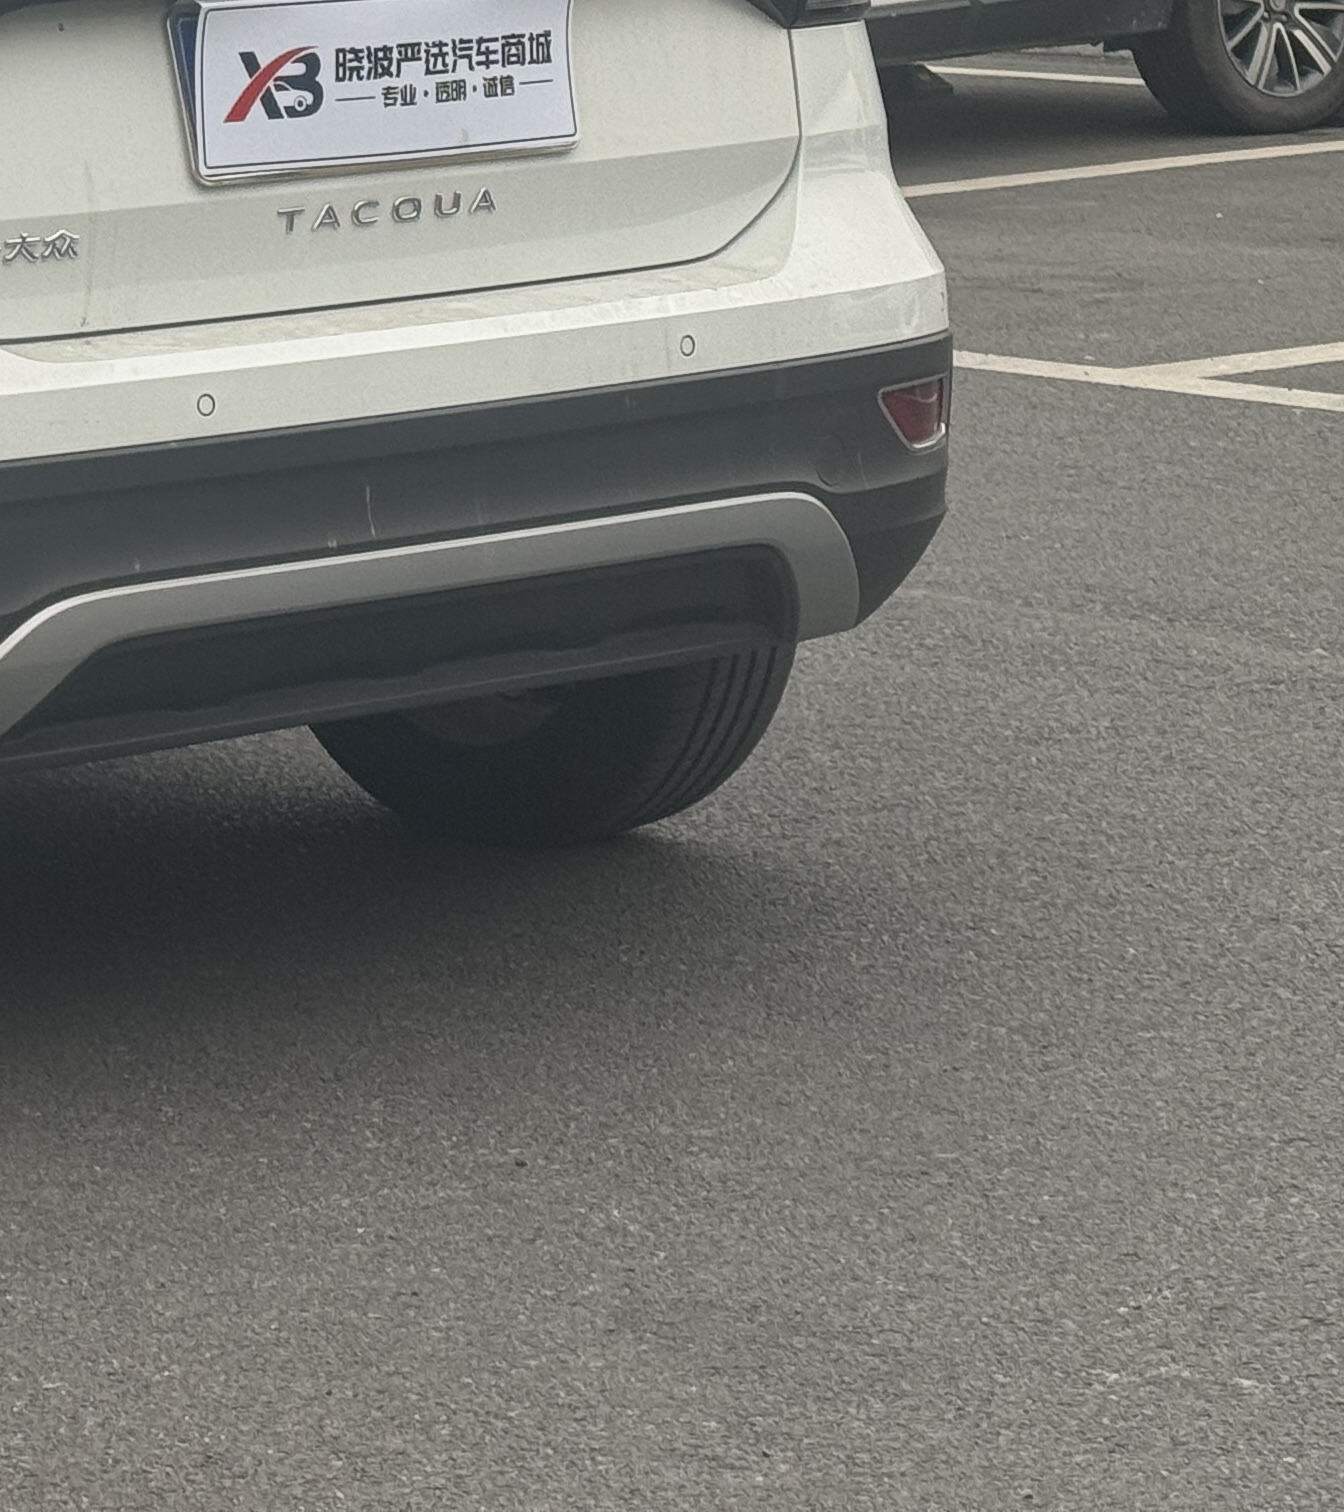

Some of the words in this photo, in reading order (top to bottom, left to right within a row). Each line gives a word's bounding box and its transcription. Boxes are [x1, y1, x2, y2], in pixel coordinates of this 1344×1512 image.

[334, 30, 553, 83] 晓波严选汽车商城
[277, 186, 498, 234] TACQUA
